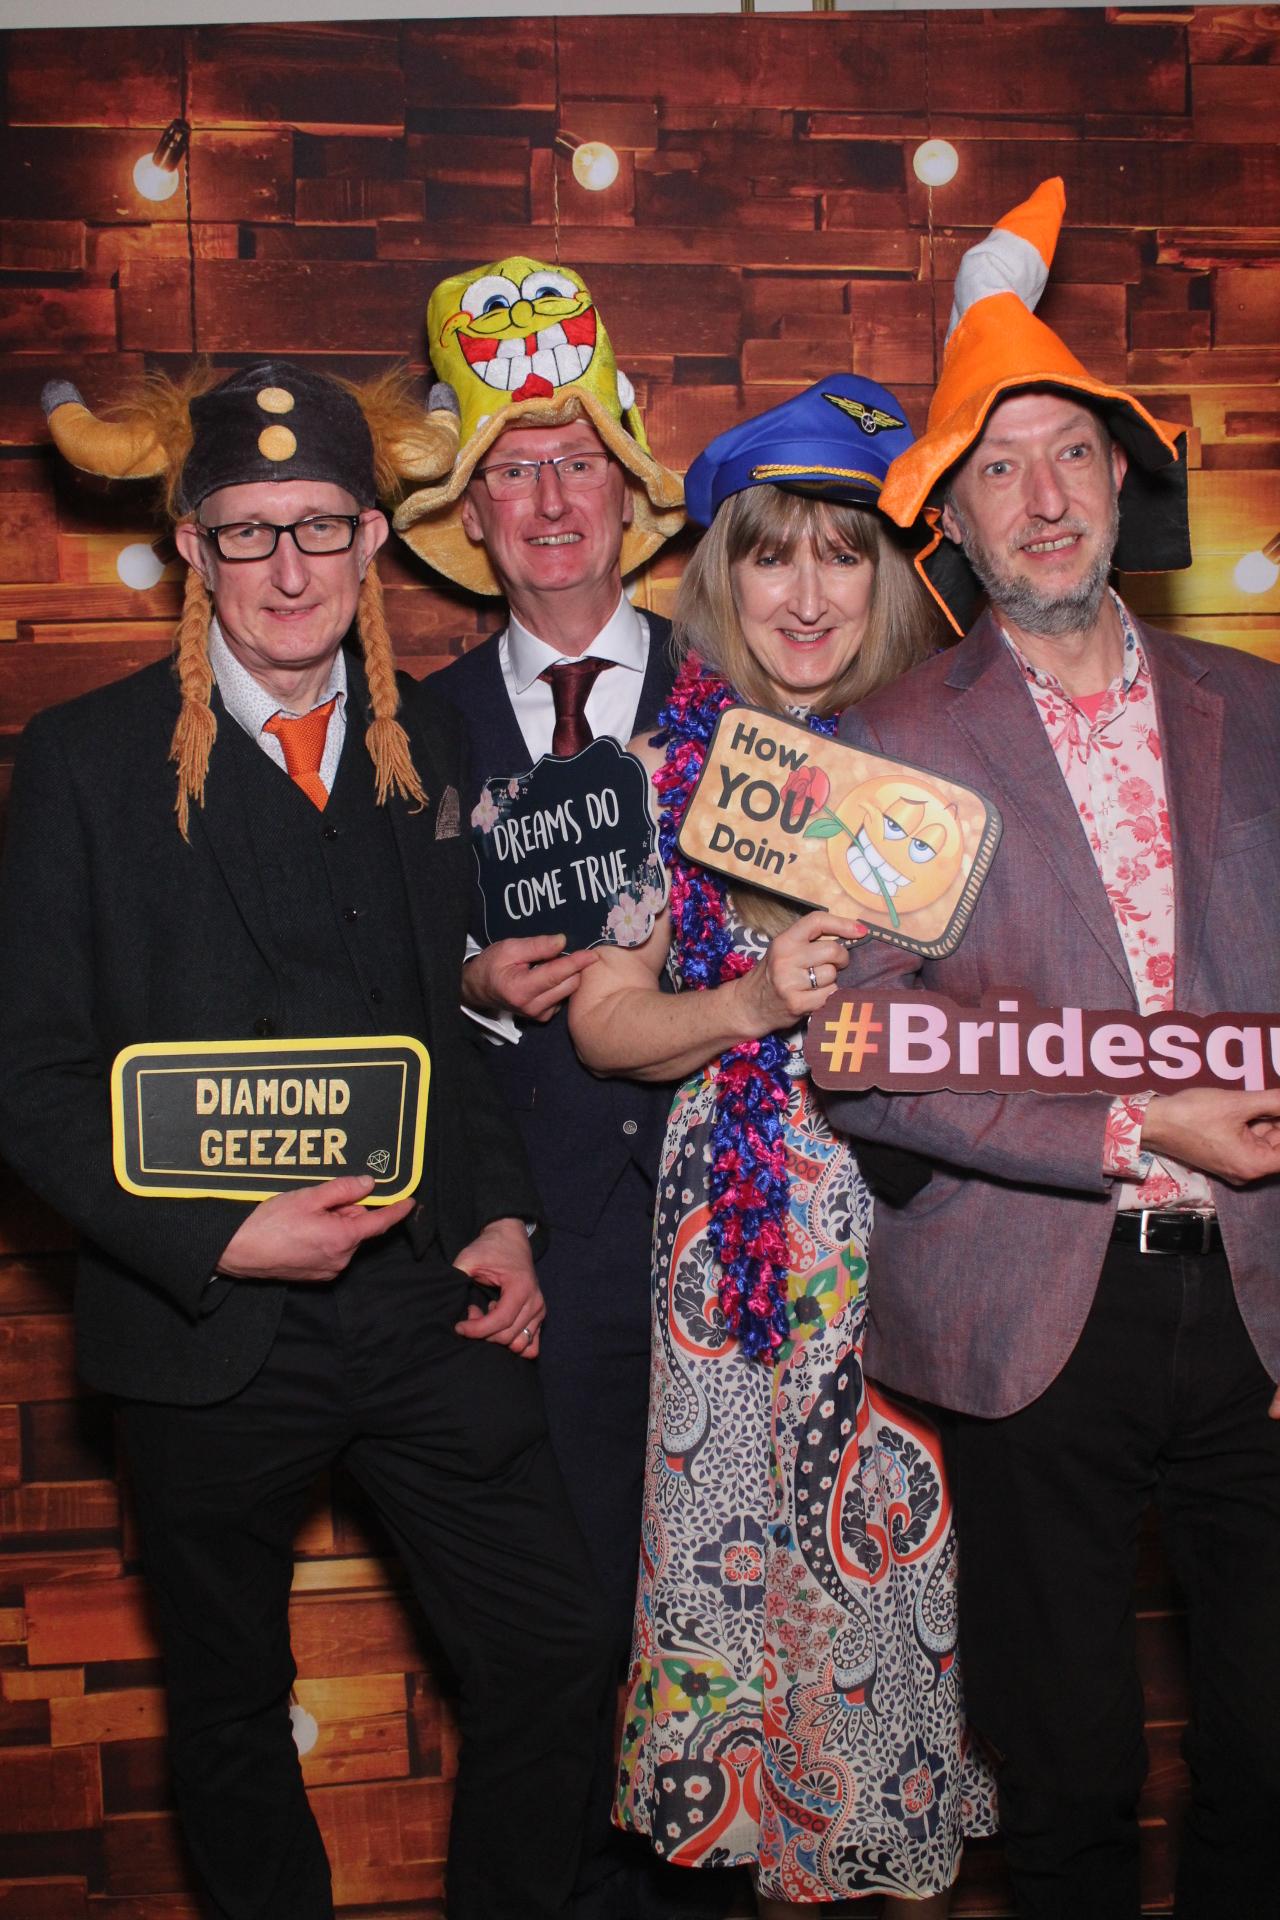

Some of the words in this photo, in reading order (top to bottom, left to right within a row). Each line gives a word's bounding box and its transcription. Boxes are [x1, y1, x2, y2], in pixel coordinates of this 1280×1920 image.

[731, 723, 808, 770] How
[493, 800, 582, 864] DREAMS
[586, 788, 619, 829] DO
[717, 765, 814, 834] YOU
[708, 823, 798, 875] Doin'
[504, 869, 567, 920] COME
[570, 849, 632, 903] TRUE
[820, 1000, 1280, 1091] #Bridesq
[196, 1078, 351, 1115] DIAMOND
[200, 1128, 348, 1167] GEEZER
